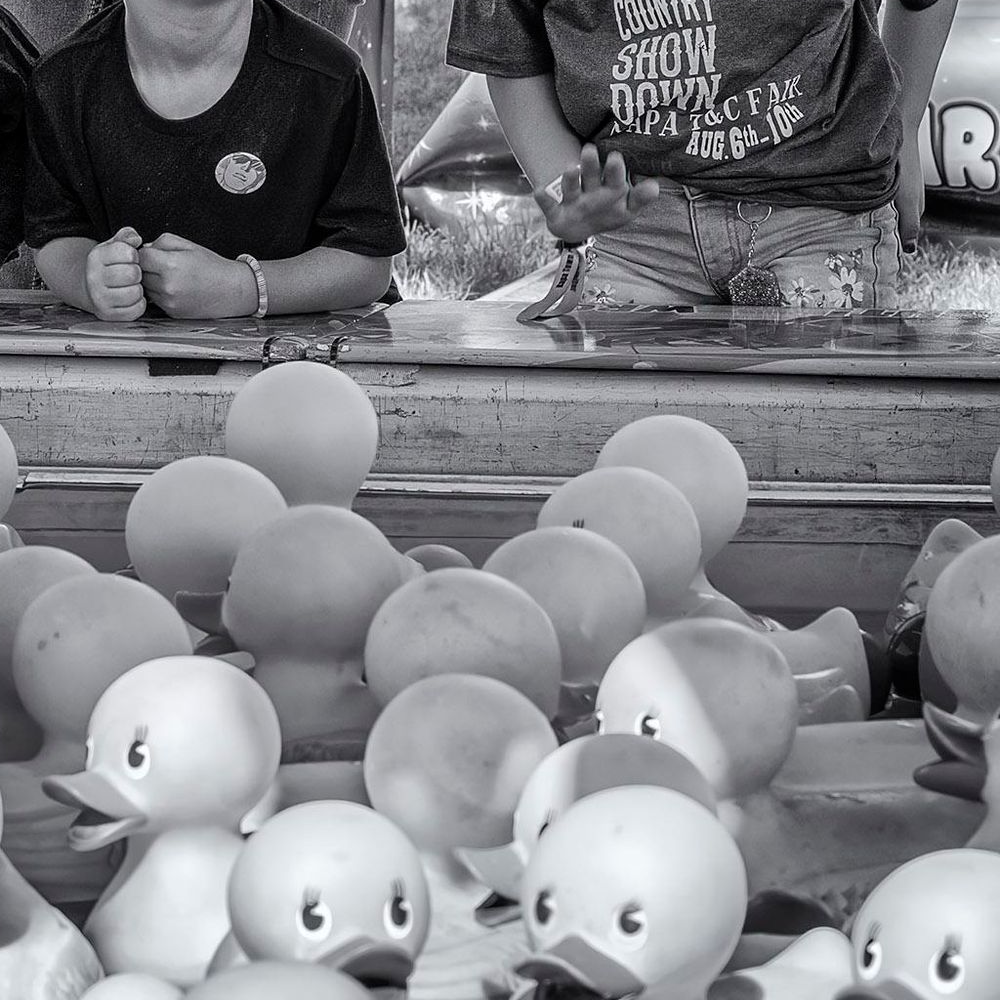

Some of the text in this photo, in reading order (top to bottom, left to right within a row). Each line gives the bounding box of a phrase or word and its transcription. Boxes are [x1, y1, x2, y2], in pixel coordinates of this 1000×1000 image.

[612, 24, 717, 80] SHOW
[610, 73, 722, 126] DOWN
[685, 131, 729, 161] AUG.
